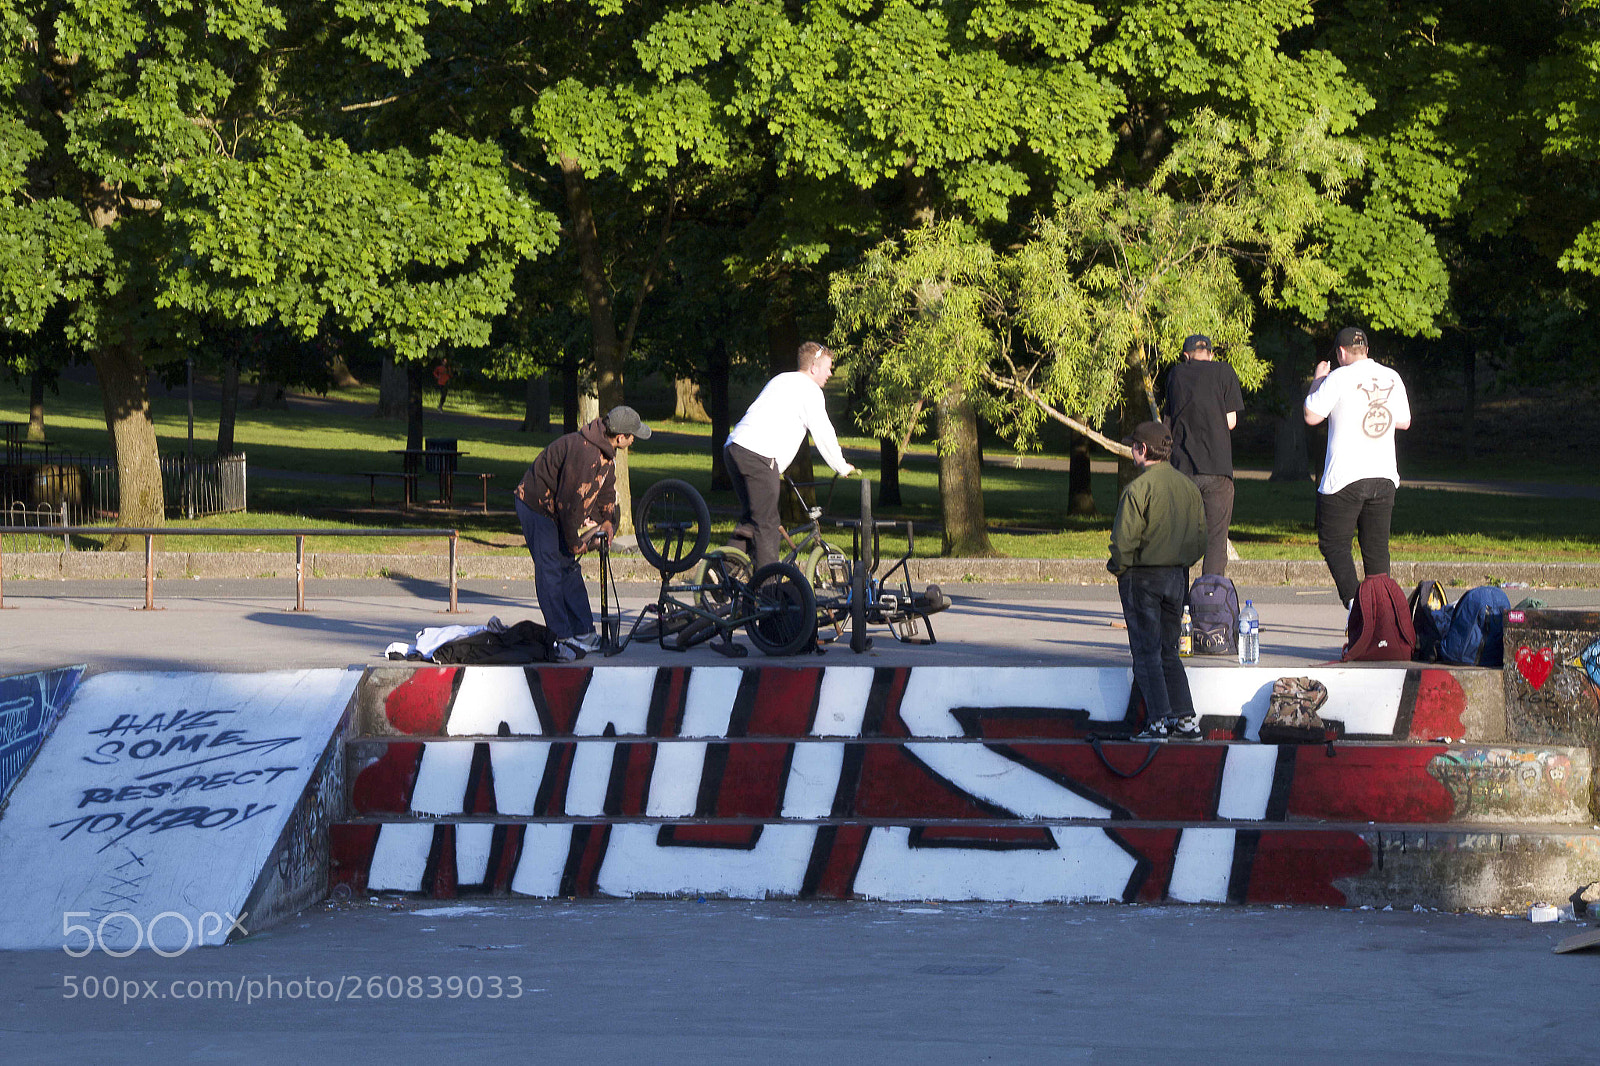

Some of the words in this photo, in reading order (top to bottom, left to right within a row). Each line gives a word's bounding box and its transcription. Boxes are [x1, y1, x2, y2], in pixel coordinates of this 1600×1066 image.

[89, 709, 237, 738] HAVE
[82, 730, 270, 765] SOME
[78, 766, 299, 808] RESPECT
